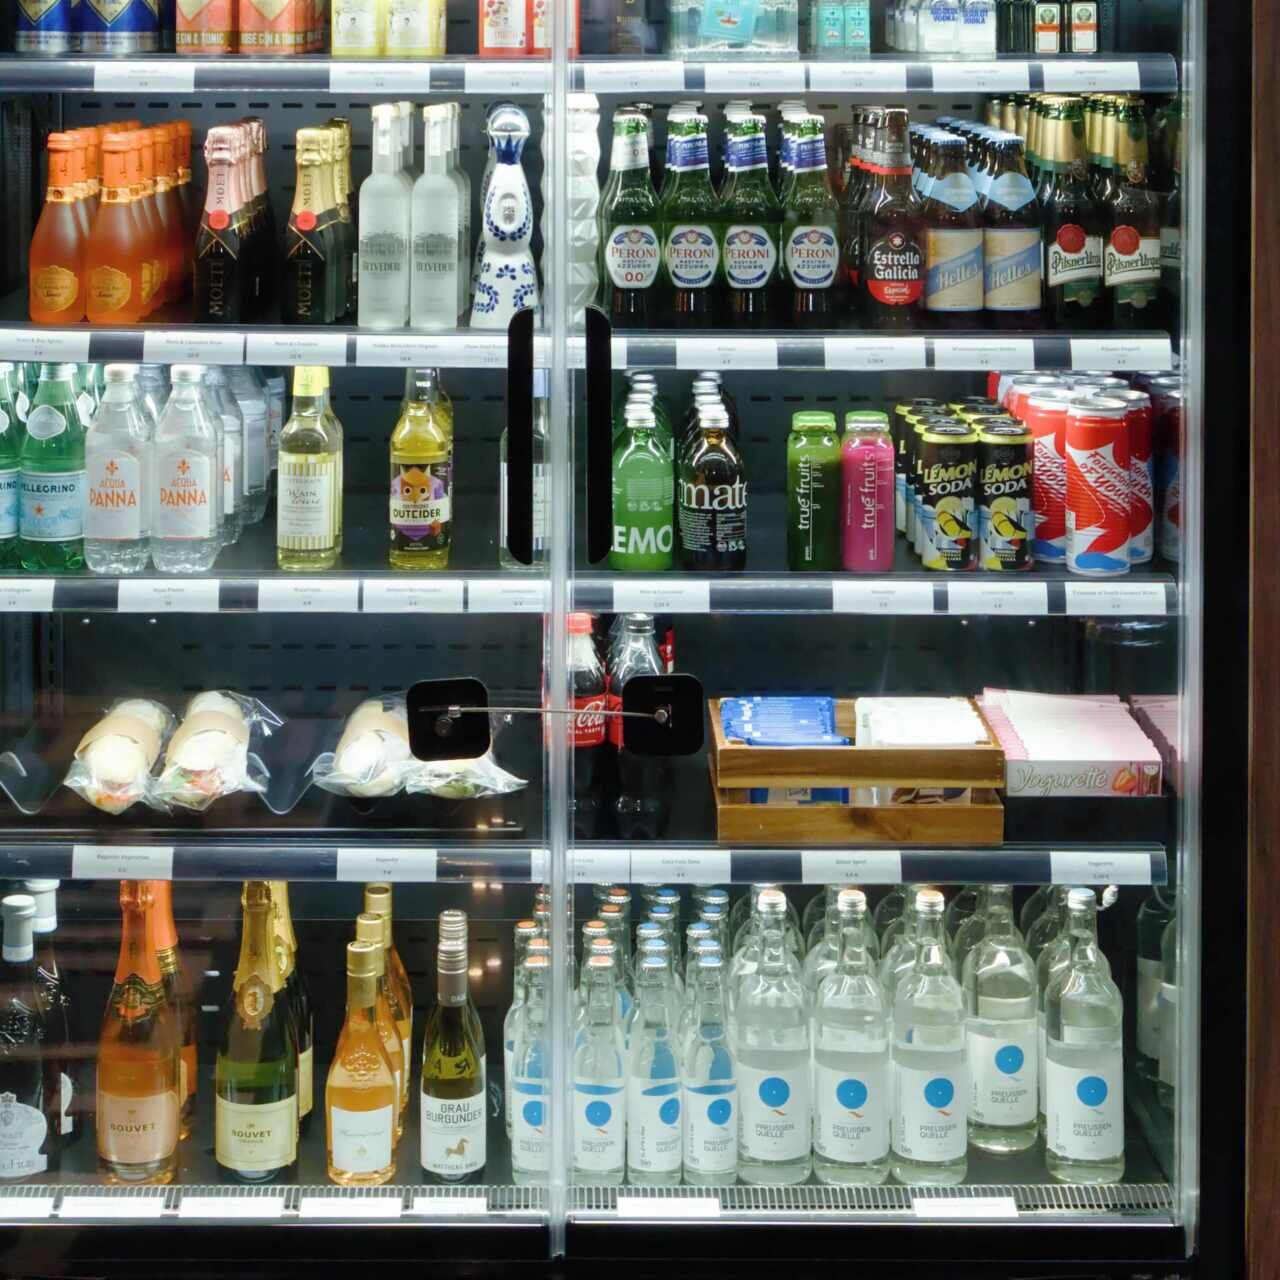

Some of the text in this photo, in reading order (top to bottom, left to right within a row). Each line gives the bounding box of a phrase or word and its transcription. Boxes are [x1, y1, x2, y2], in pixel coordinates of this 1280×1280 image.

[611, 247, 657, 258] PERONI
[670, 247, 714, 258] PERONI
[725, 247, 769, 258] PERONI
[791, 246, 836, 258] PERONI
[873, 250, 920, 265] Estrella
[874, 266, 919, 280] Galicia
[990, 262, 1031, 288] Helles
[796, 454, 810, 494] fruits
[859, 450, 875, 494] fruits
[99, 479, 127, 488] ACQUA
[171, 478, 198, 487] ACQUA
[929, 478, 972, 496] SODA
[984, 478, 1027, 496] SODA
[89, 487, 137, 507] PANNA
[160, 487, 207, 507] PANNA
[1009, 765, 1107, 797] Yogurette
